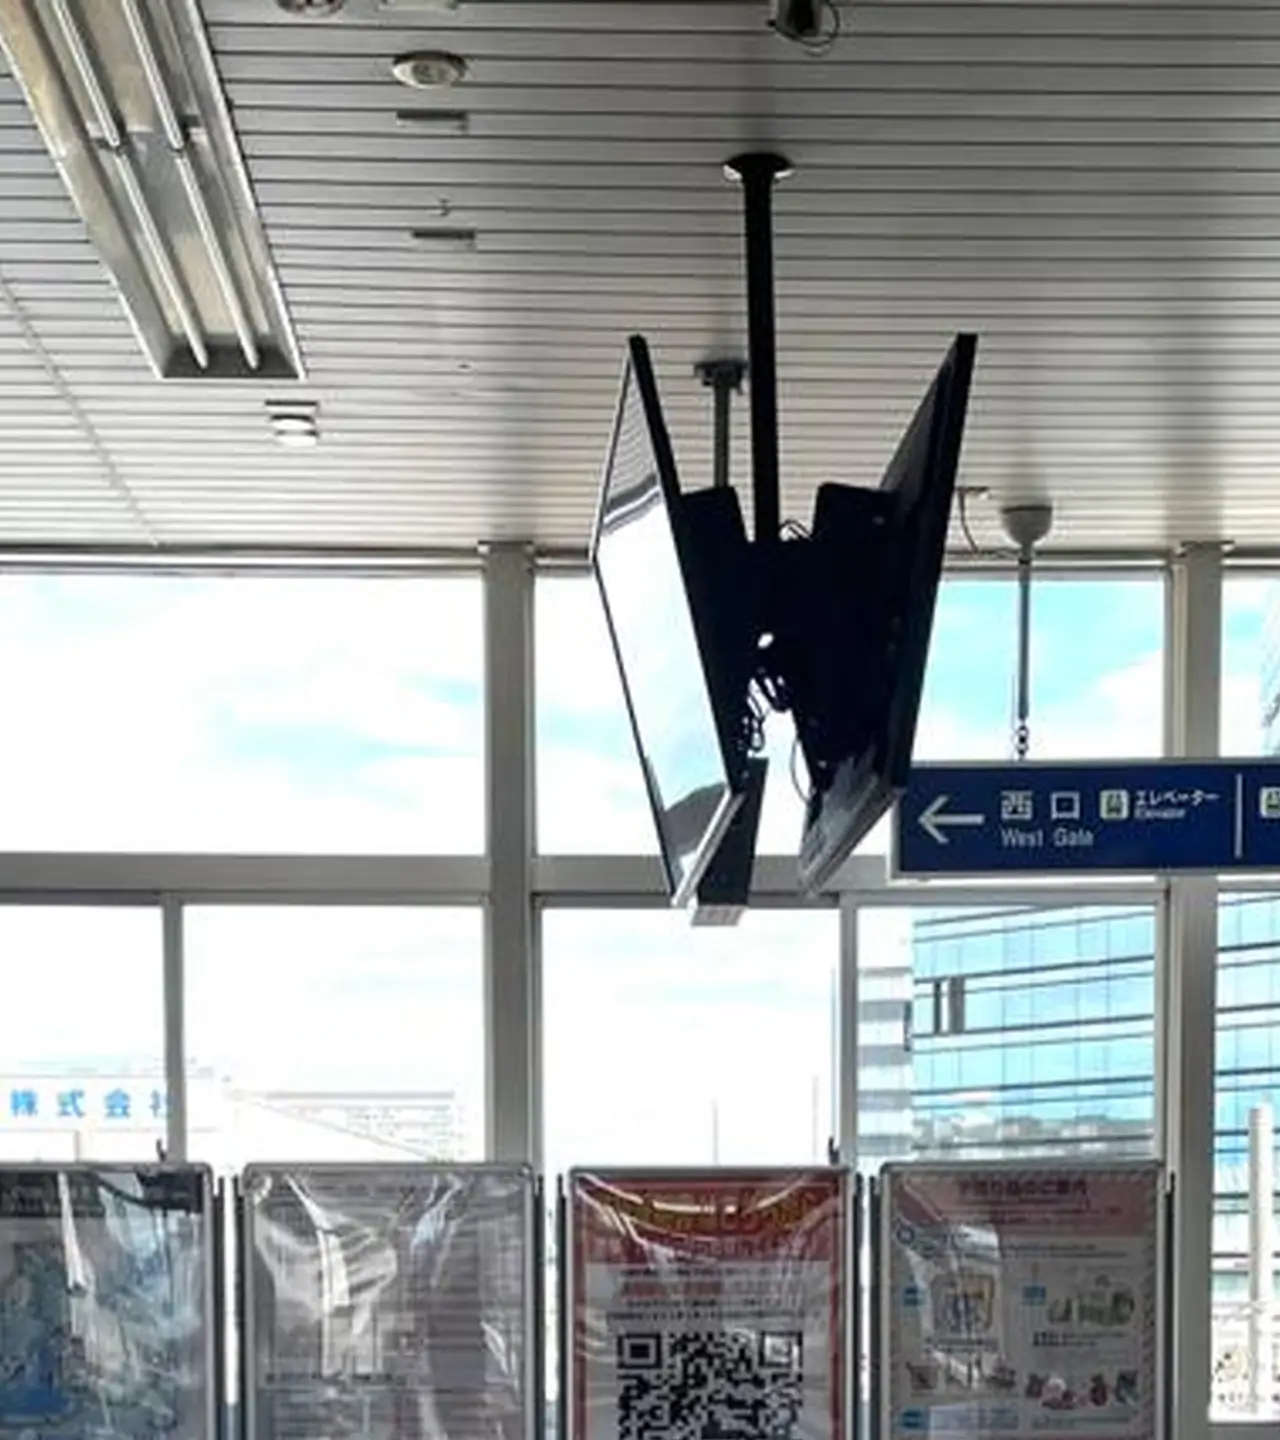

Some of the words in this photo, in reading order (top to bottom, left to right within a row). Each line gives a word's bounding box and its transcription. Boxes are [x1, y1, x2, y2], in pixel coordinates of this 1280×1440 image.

[1001, 790, 1081, 820] 西口
[1135, 789, 1220, 806] エレベーター
[1001, 828, 1044, 848] West
[1053, 828, 1094, 848] Gate
